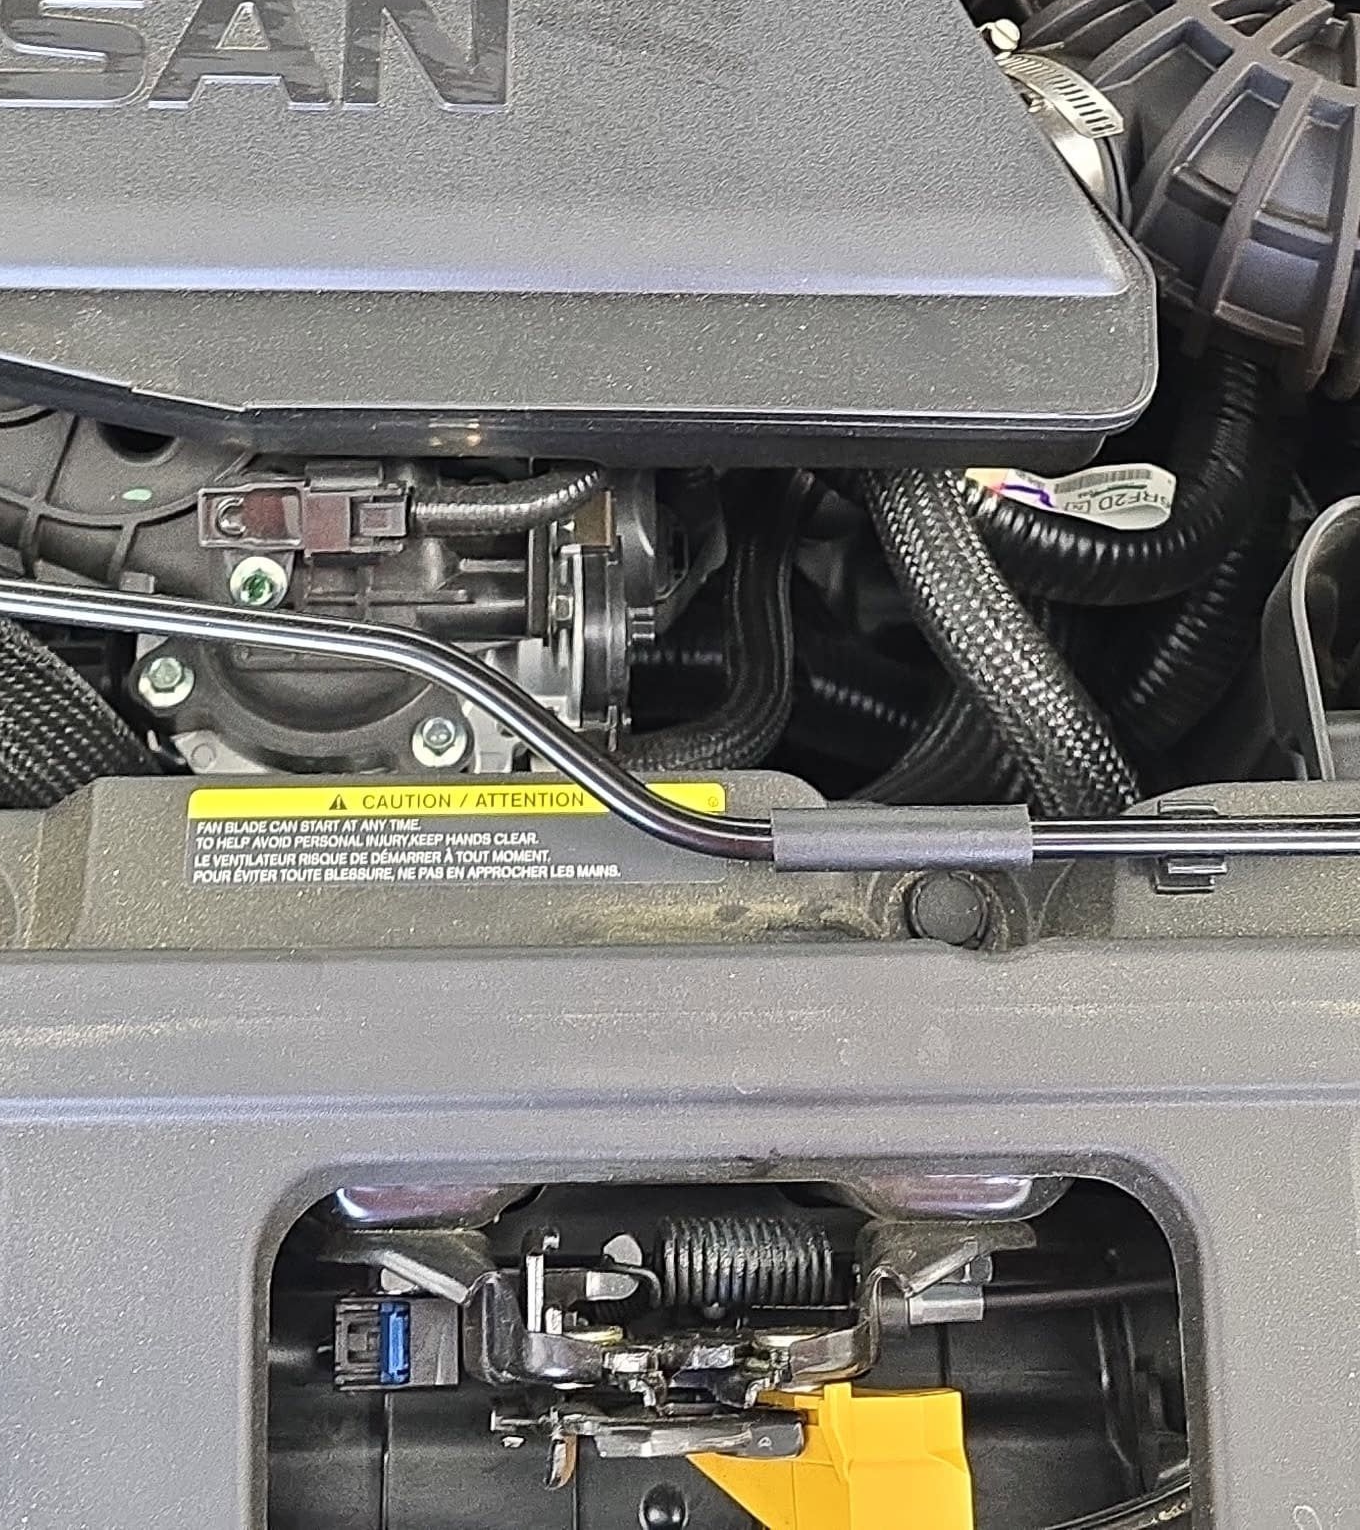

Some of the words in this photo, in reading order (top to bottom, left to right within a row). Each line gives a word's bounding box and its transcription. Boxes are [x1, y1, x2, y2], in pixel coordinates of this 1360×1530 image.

[362, 793, 451, 810] CAUTION
[475, 791, 584, 808] ATTENTION
[197, 821, 222, 834] FAN
[224, 821, 267, 833] BLADE
[269, 820, 297, 833] CAN
[300, 819, 340, 832] START
[342, 819, 358, 831] AT
[360, 818, 387, 831] ANY
[389, 818, 421, 831] TIME.
[196, 836, 214, 850] TO
[216, 836, 250, 849] HELP
[251, 835, 292, 849] AVOID
[294, 834, 364, 848] PERSONAL
[445, 832, 491, 846] HANDS
[493, 831, 539, 845] CLEAR.
[194, 854, 211, 868] LE
[212, 852, 296, 869] VENTILATEUR
[298, 851, 347, 866] RISQUE
[349, 851, 368, 865] DE
[370, 848, 441, 864] DÉMARRER
[456, 850, 490, 863] TOUT
[193, 870, 231, 883] POUR
[233, 866, 277, 885] ÉVITER
[280, 868, 322, 882] TOUTE
[324, 867, 395, 882] BLESSURE,
[397, 867, 417, 880] NE
[418, 866, 444, 880] PAS
[446, 866, 465, 880] EN
[467, 865, 548, 880] APPROCHER
[551, 864, 575, 878] LES
[577, 864, 622, 878] MAINS.
